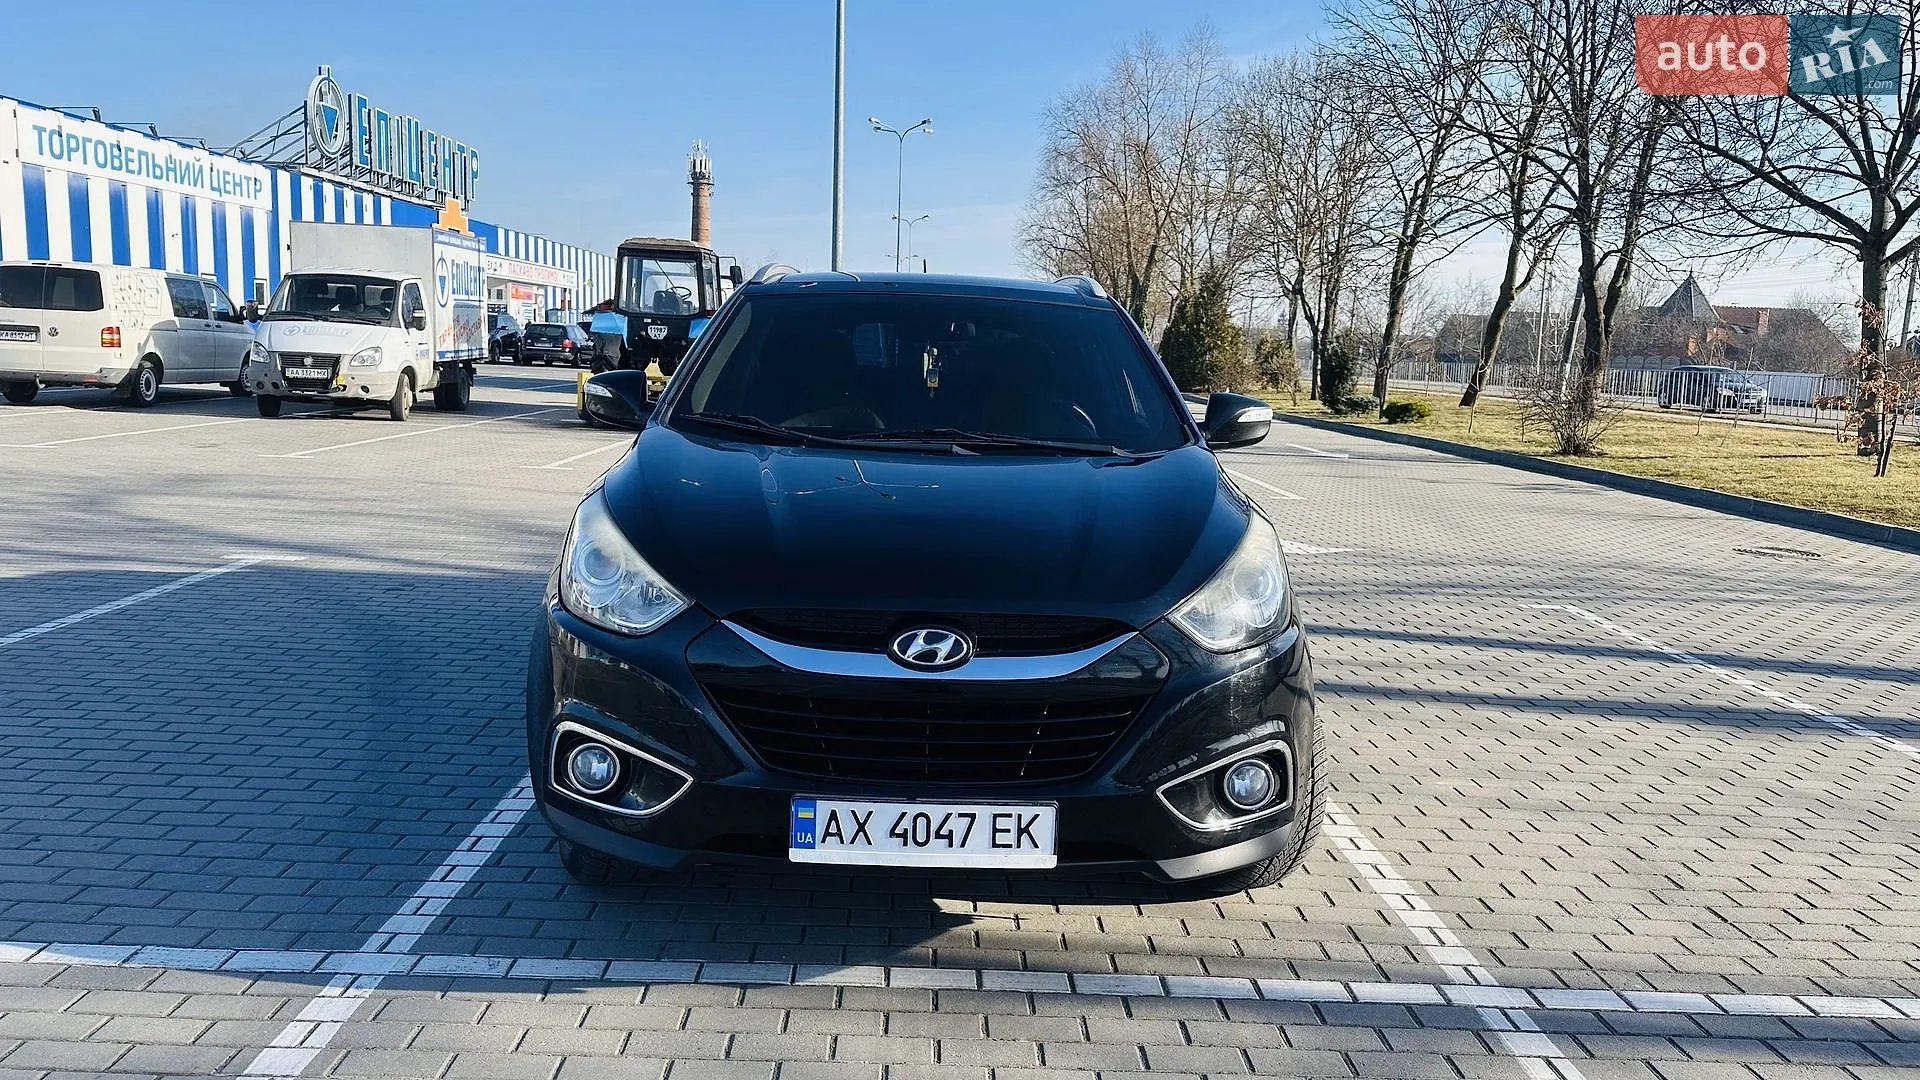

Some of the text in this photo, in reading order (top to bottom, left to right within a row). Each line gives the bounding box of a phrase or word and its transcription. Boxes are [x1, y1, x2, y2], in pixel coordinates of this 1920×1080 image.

[32, 124, 263, 200] ТОРГОВЕЛЬНИЙ ЦЕНТР
[797, 832, 814, 844] UA
[820, 808, 1042, 849] AX 4047 EK
